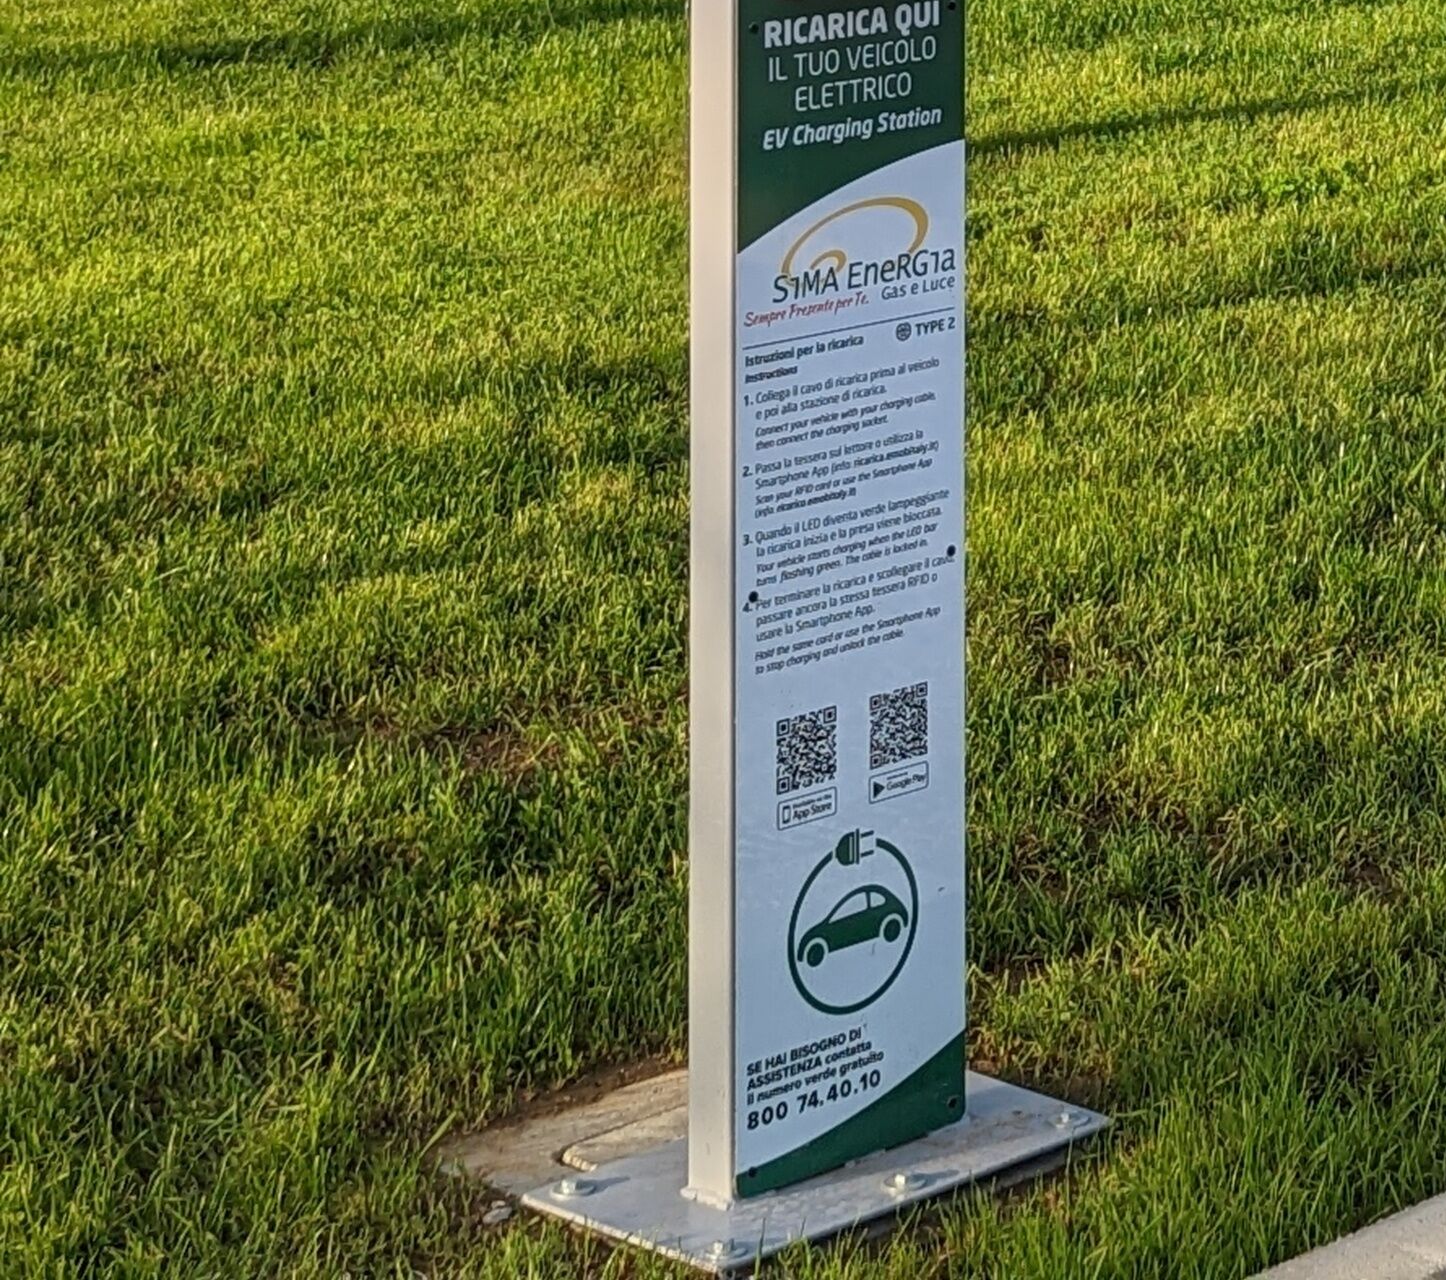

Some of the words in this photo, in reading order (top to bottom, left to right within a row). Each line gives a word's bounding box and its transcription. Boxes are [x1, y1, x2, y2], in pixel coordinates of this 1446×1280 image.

[764, 5, 889, 49] RICARICA
[894, 0, 940, 37] QUI
[768, 56, 788, 82] IL
[794, 48, 840, 79] TUO
[846, 35, 938, 72] VEICOLO
[795, 71, 913, 112] ELETTRICO
[763, 126, 790, 151] EV
[792, 117, 873, 146] Charging
[877, 106, 943, 133] Station
[881, 283, 906, 301] Gas
[911, 283, 919, 296] e
[922, 276, 956, 293] Luce
[744, 307, 786, 328] Sempre
[789, 300, 834, 320] Presente
[834, 297, 853, 316] per
[915, 320, 945, 337] TYPE
[948, 316, 956, 329] 2
[745, 346, 795, 368] Istruzioni
[796, 344, 814, 359] per
[816, 341, 826, 353] la
[827, 334, 864, 351] ricarica
[744, 394, 754, 407] 1.
[755, 388, 791, 404] Collega
[792, 384, 798, 396] il
[800, 382, 822, 395] cavo
[824, 378, 834, 390] di
[835, 372, 868, 387] ricarica
[870, 366, 896, 383] prima
[897, 362, 906, 375] al
[907, 356, 940, 373] veicolo
[745, 365, 798, 384] Instructions
[755, 422, 789, 438] Connect
[789, 419, 809, 434] your
[810, 412, 839, 426] vehicle
[860, 404, 879, 418] your
[879, 396, 914, 412] charging
[764, 404, 779, 421] poi
[781, 401, 798, 415] alla
[800, 394, 840, 411] stazione
[841, 389, 850, 402] di
[742, 465, 753, 478] 2.
[755, 461, 782, 475] Passa
[784, 458, 792, 469] la
[794, 451, 827, 466] tessera
[829, 444, 842, 459] sul
[844, 441, 874, 456] lettore
[883, 431, 914, 447] utilizza
[915, 429, 924, 440] la
[755, 469, 810, 491] Smartphone
[811, 465, 829, 479] App
[742, 533, 753, 546] 3.
[755, 525, 792, 545] Quando
[794, 521, 800, 533] il
[802, 517, 821, 532] LED
[822, 511, 858, 527] diventa
[860, 503, 886, 518] verde
[756, 546, 766, 558] la
[767, 539, 801, 556] ricarica
[803, 533, 828, 547] inizia
[838, 528, 847, 539] la
[848, 523, 874, 539] presa
[876, 515, 902, 530] viene
[756, 562, 775, 574] Your
[777, 554, 806, 568] vehicle
[807, 549, 831, 562] starts
[832, 540, 866, 556] charging
[868, 535, 890, 547] when
[891, 531, 905, 542] the
[906, 525, 923, 538] LED
[923, 522, 939, 534] bar
[756, 609, 793, 628] passare
[795, 601, 827, 616] ancora
[829, 596, 838, 607] la
[839, 589, 870, 605] stessa
[871, 580, 906, 597] tessera
[907, 572, 930, 587] RFID
[774, 587, 821, 606] terminare
[822, 583, 831, 594] la
[833, 575, 866, 591] ricarica
[876, 561, 923, 582] scollegare
[924, 557, 930, 569] il
[756, 627, 783, 643] usare
[784, 623, 793, 634] la
[795, 610, 853, 633] Smartphone
[792, 806, 810, 821] App
[811, 802, 832, 816] Store
[747, 1059, 762, 1077] SE
[765, 1052, 787, 1071] HAI
[790, 1032, 847, 1061] BISOGNO
[849, 1026, 862, 1041] DI
[747, 1055, 823, 1092] ASSISTENZA
[825, 1041, 872, 1065] contatta
[757, 1079, 802, 1103] numero
[804, 1067, 837, 1087] verde
[839, 1051, 885, 1077] gratuito
[747, 1101, 788, 1130] 800
[797, 1069, 882, 1115] 74.40.10
